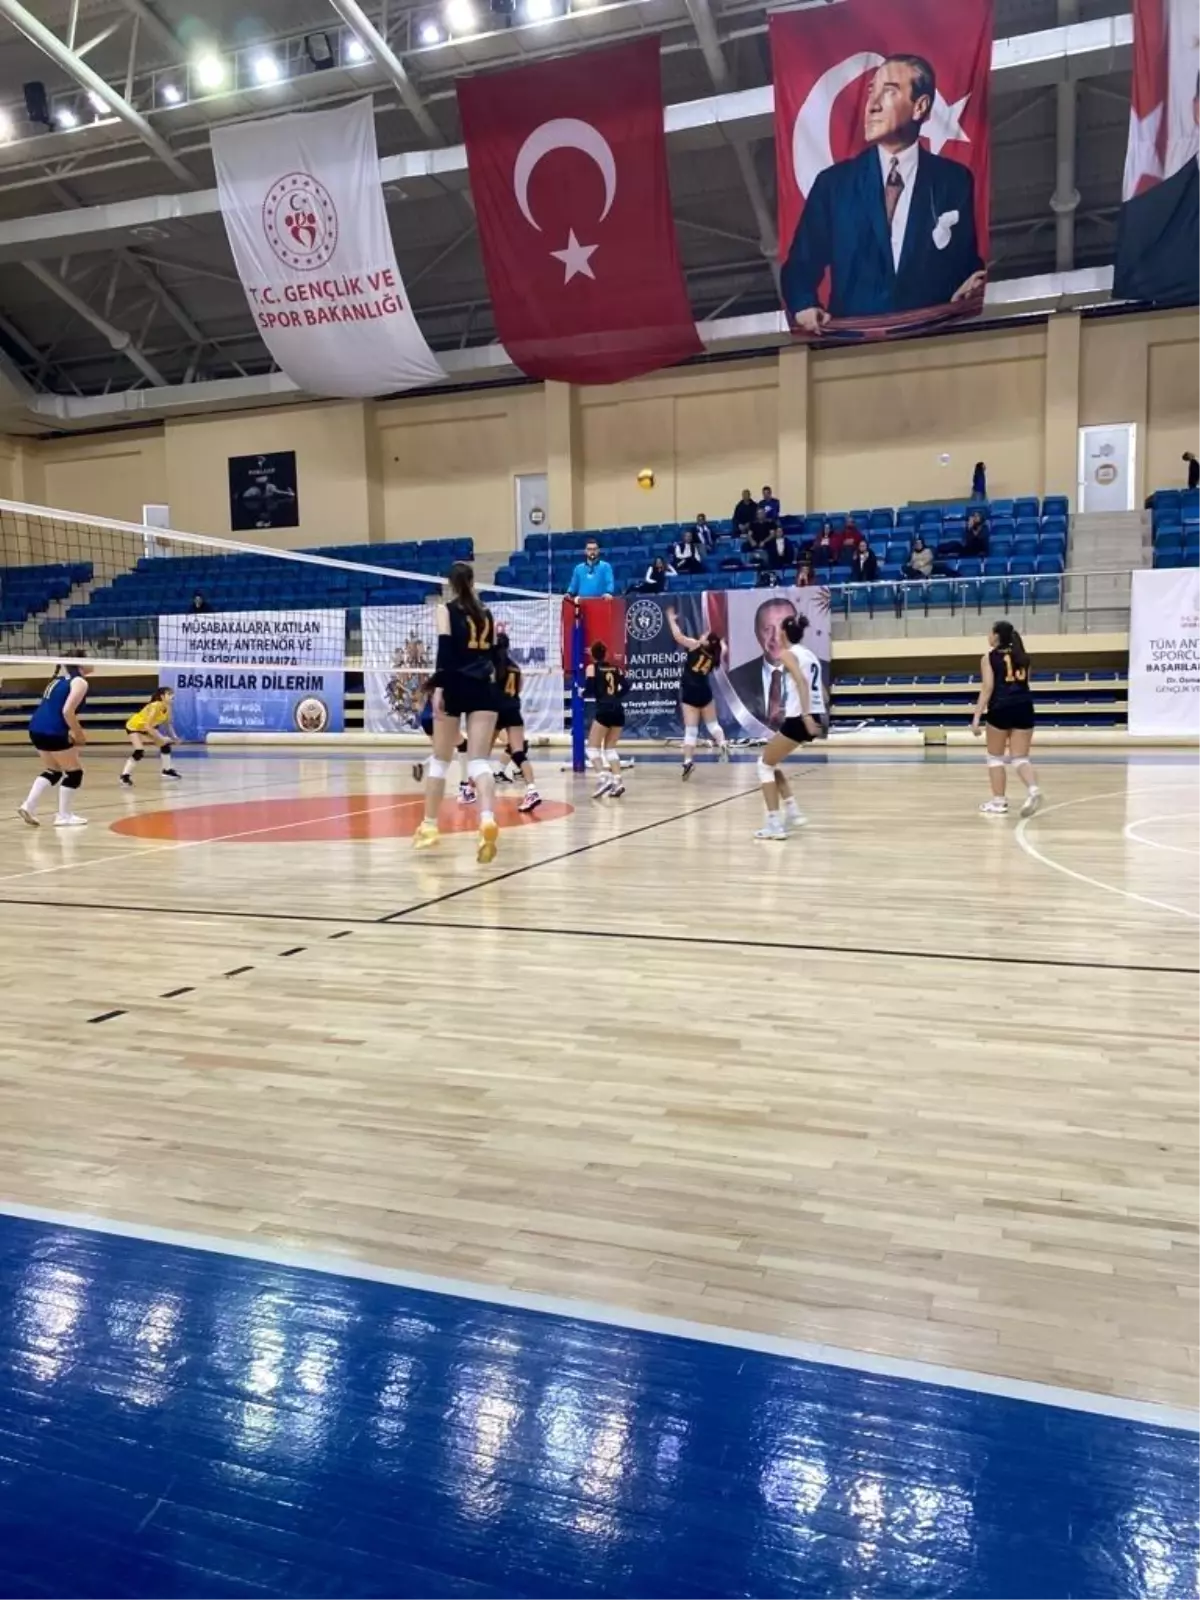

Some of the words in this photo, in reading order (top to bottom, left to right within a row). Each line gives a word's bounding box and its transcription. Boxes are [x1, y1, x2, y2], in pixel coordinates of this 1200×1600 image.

[250, 286, 281, 305] T.C.
[284, 274, 364, 302] GENÇLİK
[367, 268, 396, 291] VE
[258, 309, 302, 328] SPOR
[303, 293, 404, 326] BAKANLIĞI
[182, 619, 271, 634] MÜSABAKALARA
[274, 621, 320, 634] KATILAN
[466, 615, 491, 650] 12
[189, 639, 232, 653] HAKEM,
[234, 637, 295, 651] ANTRENÖR
[297, 638, 313, 651] VE
[1149, 637, 1177, 650] TÜM
[177, 674, 257, 692] BAŞARILAR
[261, 671, 324, 691] DİLERİM
[504, 672, 517, 697] 4
[605, 672, 615, 696] 3
[644, 680, 681, 691] DİLİYOR
[810, 663, 819, 691] 2
